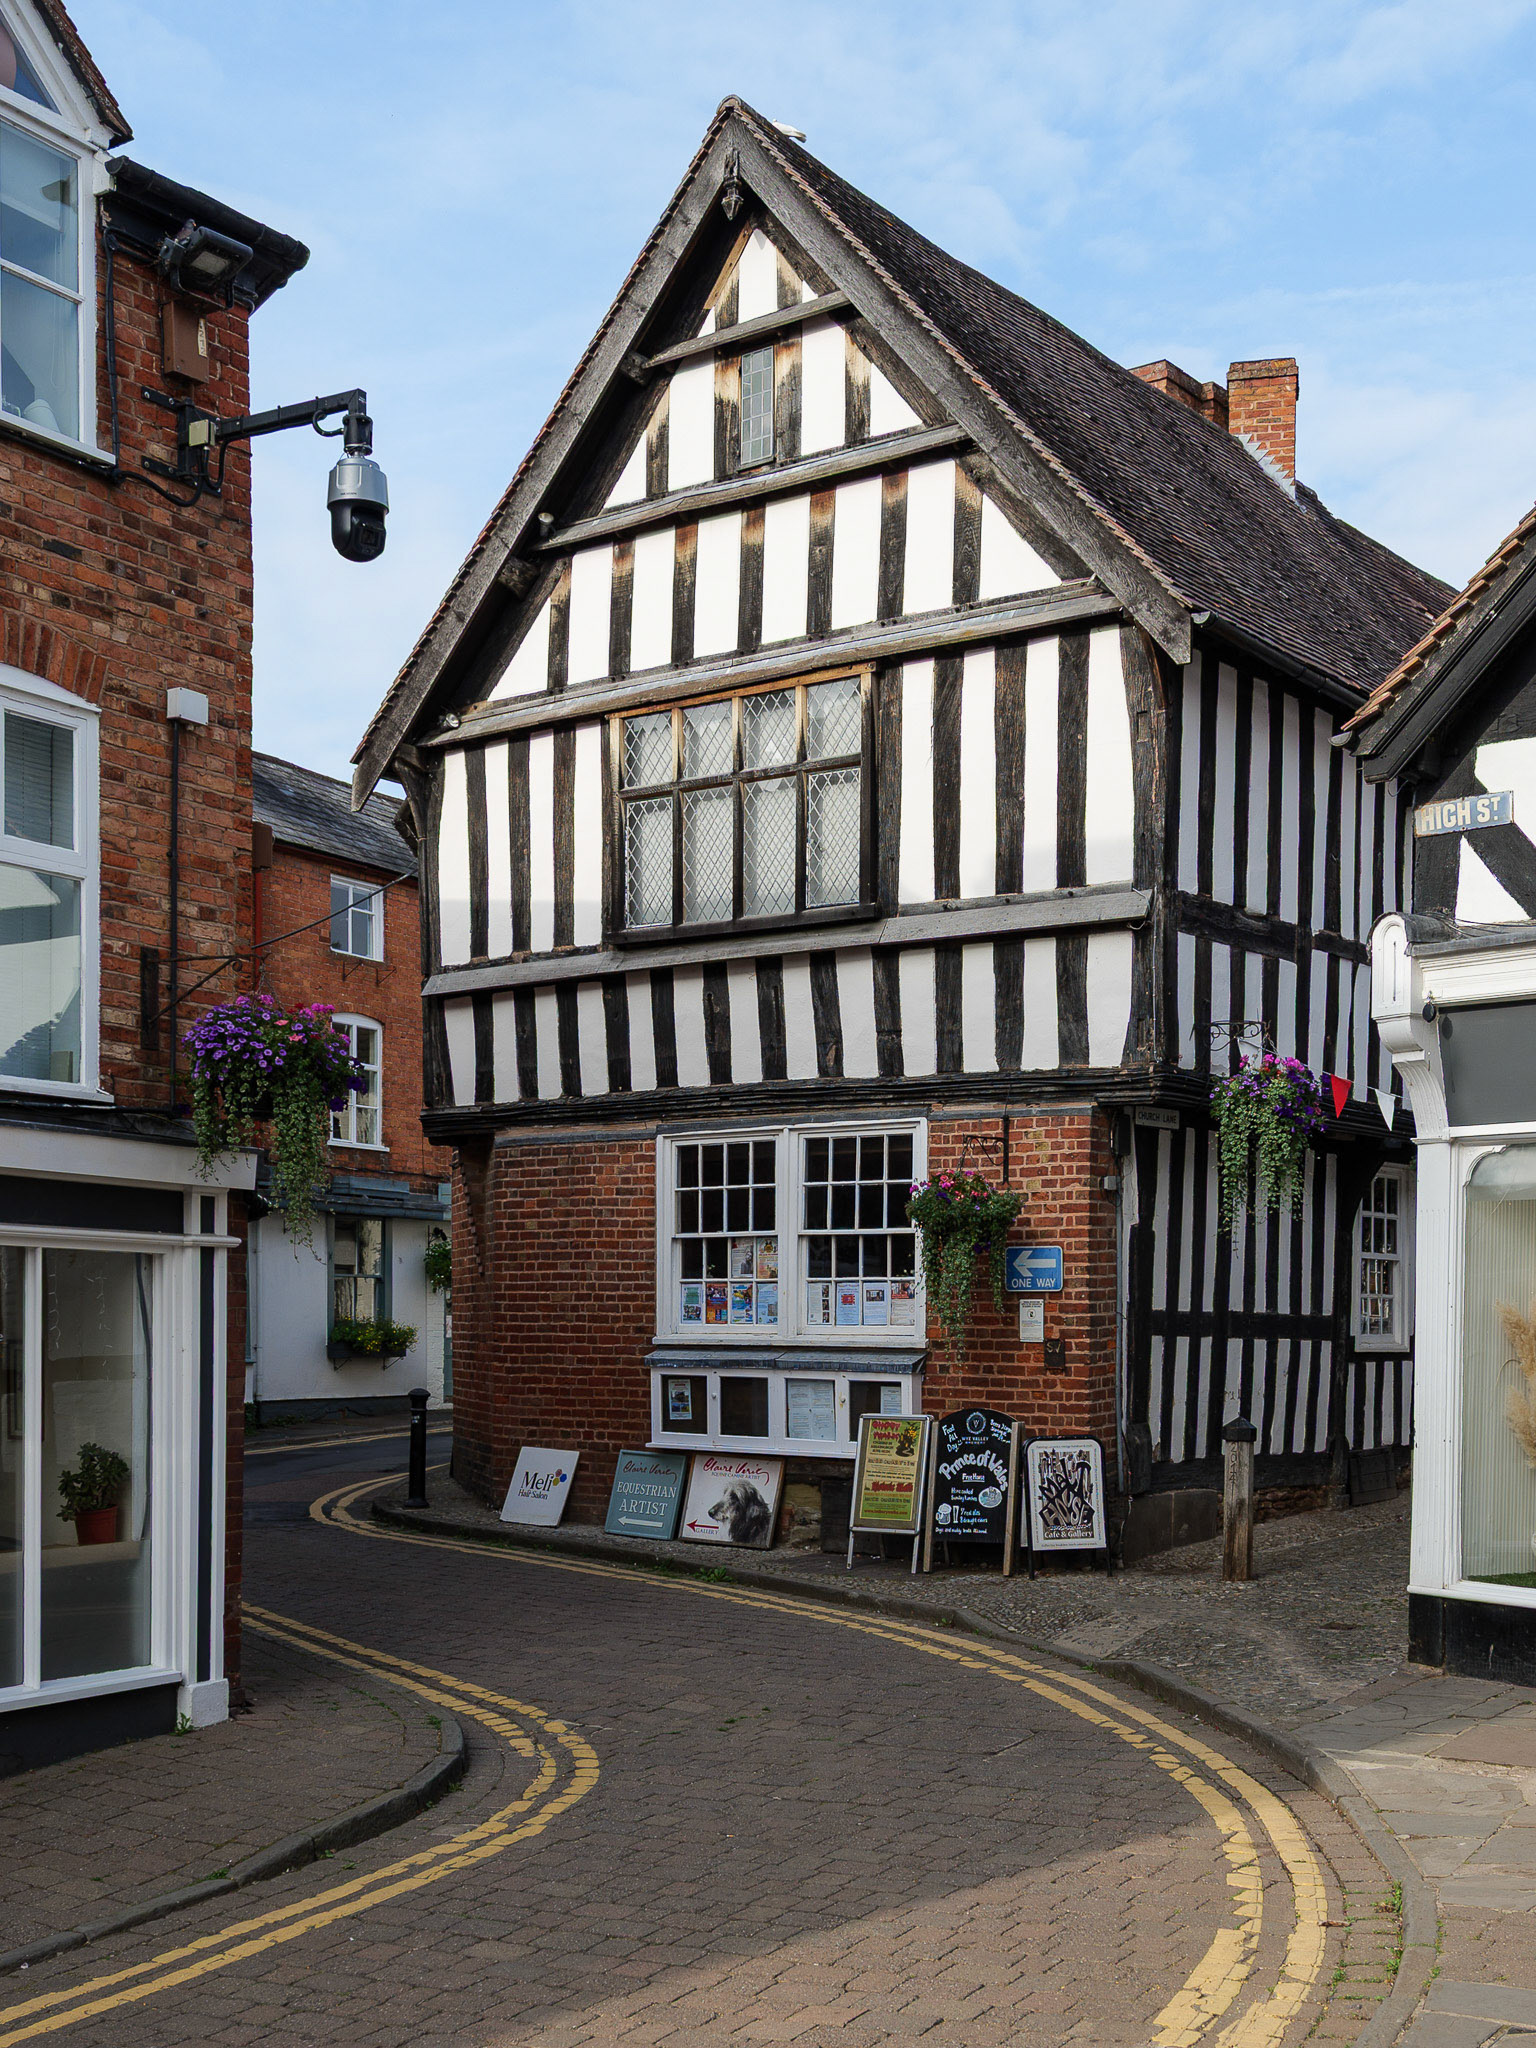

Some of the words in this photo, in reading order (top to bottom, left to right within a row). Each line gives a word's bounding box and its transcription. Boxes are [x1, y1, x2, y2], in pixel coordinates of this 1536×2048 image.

[1421, 801, 1472, 831] HIGH
[1138, 1111, 1160, 1122] CHURCH
[1163, 1114, 1177, 1124] LANE
[1011, 1278, 1032, 1289] ONE
[1036, 1277, 1057, 1288] WAY
[942, 1424, 956, 1436] Food
[946, 1443, 959, 1452] Day
[703, 1456, 733, 1472] Claire
[938, 1453, 977, 1480] Prince
[976, 1449, 991, 1467] of
[988, 1452, 1009, 1492] Wales
[520, 1471, 554, 1491] Meli
[962, 1473, 972, 1481] Free
[1039, 1458, 1092, 1499] MALT
[531, 1490, 549, 1500] Salon
[617, 1481, 677, 1498] EQUESTRIAN
[618, 1498, 668, 1516] ARTIST
[1039, 1488, 1095, 1526] HOUSE
[1061, 1530, 1067, 1538] &
[1067, 1530, 1093, 1538] Gallery
